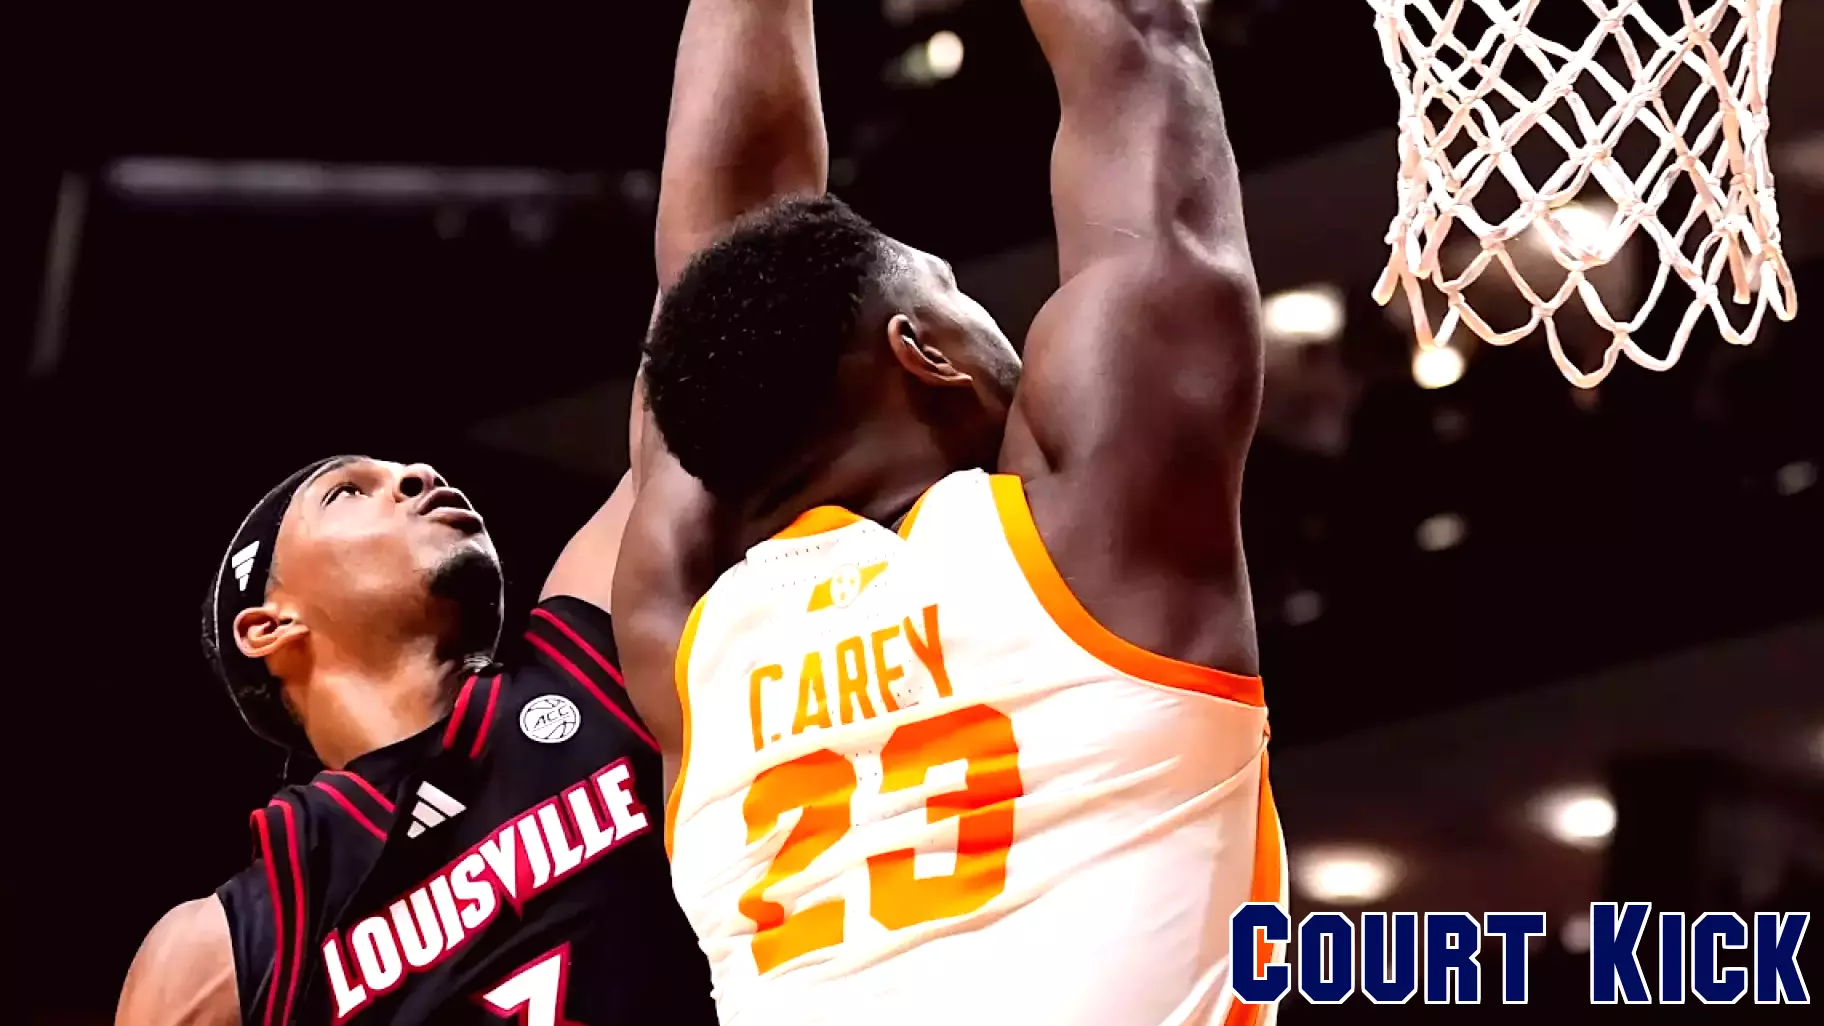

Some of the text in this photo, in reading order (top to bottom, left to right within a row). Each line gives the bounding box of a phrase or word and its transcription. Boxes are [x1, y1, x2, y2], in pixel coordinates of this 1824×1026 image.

[532, 704, 570, 729] ACC
[748, 603, 954, 752] CAREY
[321, 757, 651, 1024] LOUISVILLE
[738, 703, 1024, 976] 23
